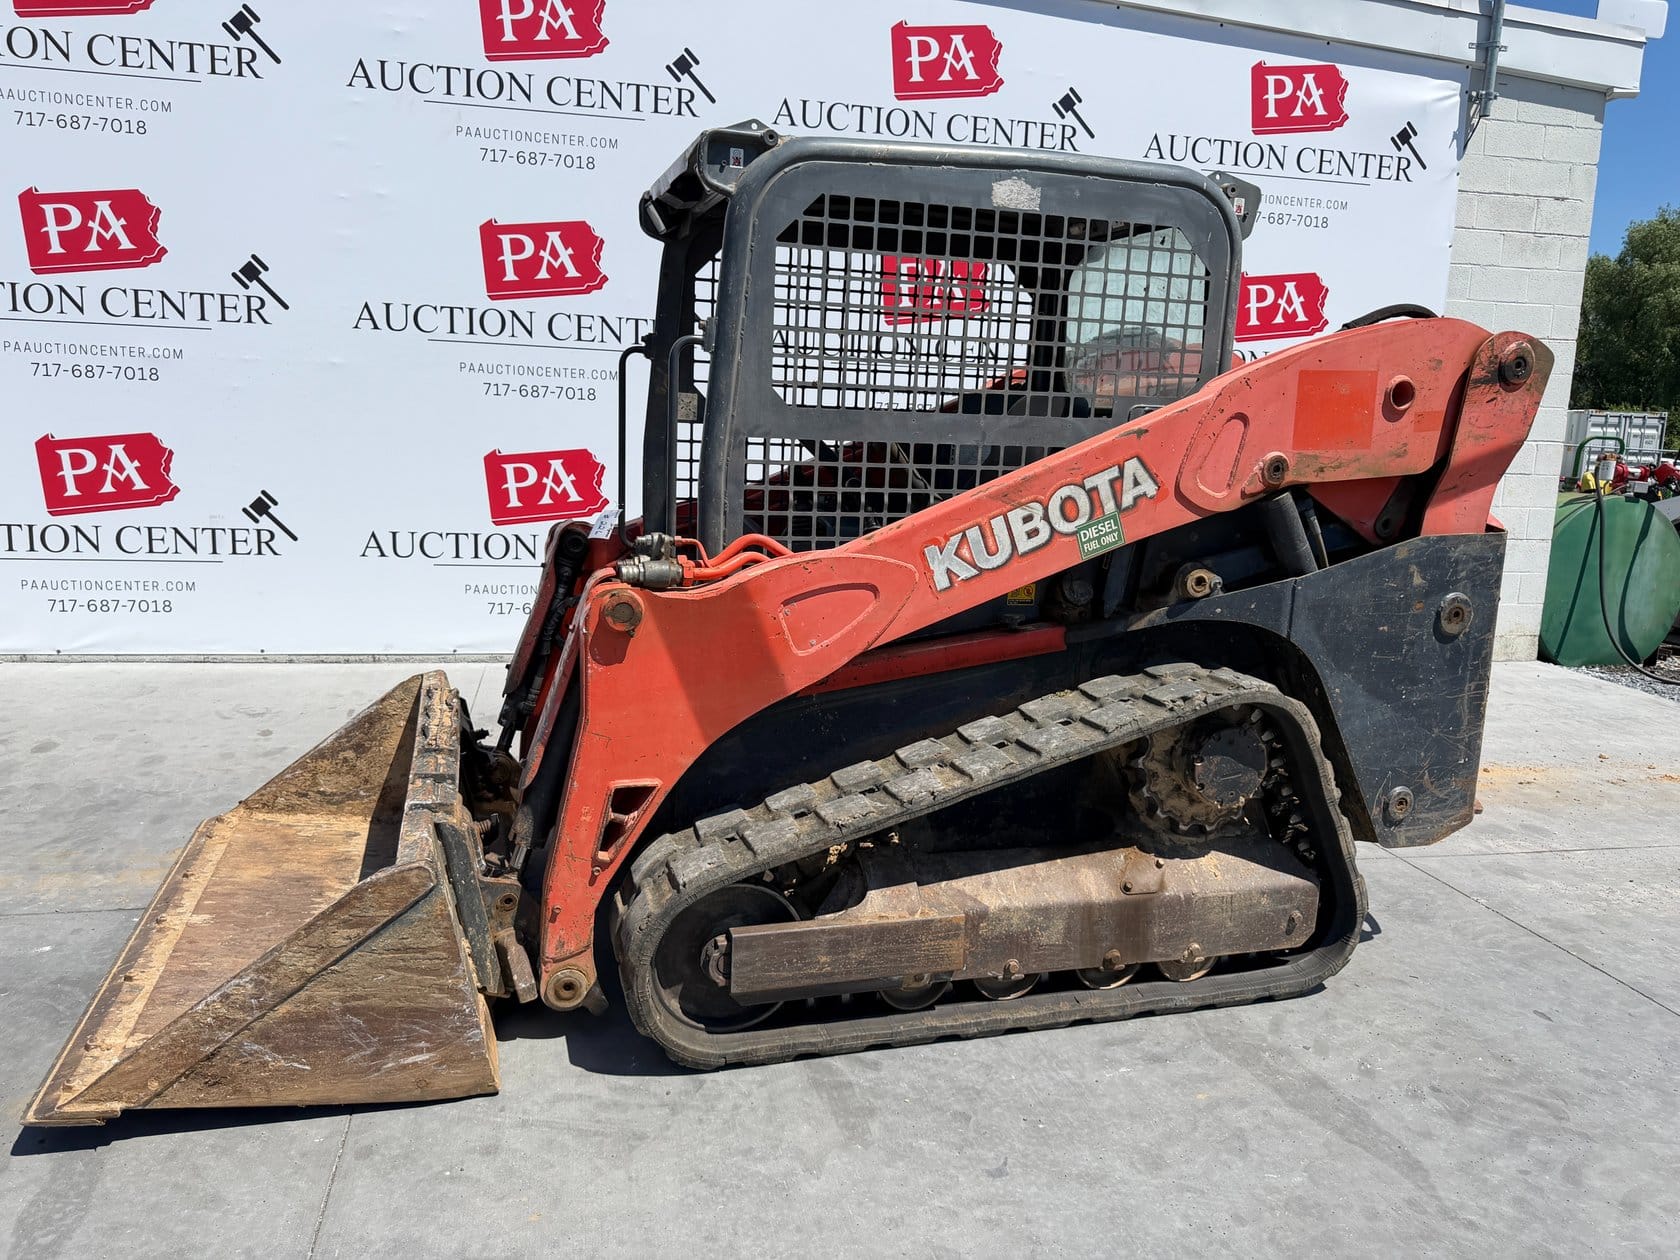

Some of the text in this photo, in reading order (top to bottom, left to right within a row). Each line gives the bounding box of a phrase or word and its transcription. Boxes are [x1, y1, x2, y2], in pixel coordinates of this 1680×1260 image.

[496, 0, 583, 41] PA
[0, 25, 264, 79] ON CENTER
[906, 34, 981, 82] PA
[346, 58, 700, 117] AUCTION CENTER
[1263, 73, 1328, 118] PA
[14, 110, 147, 135] 717-687-7018
[456, 125, 618, 149] PAAUCTIONCENTER.COM
[772, 97, 1080, 152] AUCTION CENTER
[480, 147, 595, 170] 717-687-7018
[1143, 133, 1413, 182] AUCTION CENTER
[40, 200, 137, 254] PA
[497, 231, 583, 282] PA
[101, 287, 272, 325] CENTER
[353, 301, 536, 339] AUCTION
[1245, 281, 1308, 326] PA
[3, 340, 183, 359] PAAUCTIONCENTER.COM
[30, 362, 159, 382] 717-687-7018
[459, 361, 618, 381] PAAUCTIONCENTER.COM
[483, 382, 597, 401] 717-687-7018
[55, 444, 150, 496] PA
[501, 459, 584, 508] PA
[116, 526, 281, 556] CENTER
[924, 456, 1158, 591] KUBOTA
[1080, 519, 1118, 542] DIESEL
[1083, 531, 1119, 552] FUEL ONLY
[359, 530, 538, 560] AUCTION
[21, 579, 196, 592] PAAUCTIONCENTER.COM
[47, 599, 173, 613] 717-687-7018
[488, 602, 532, 615] 717-6
